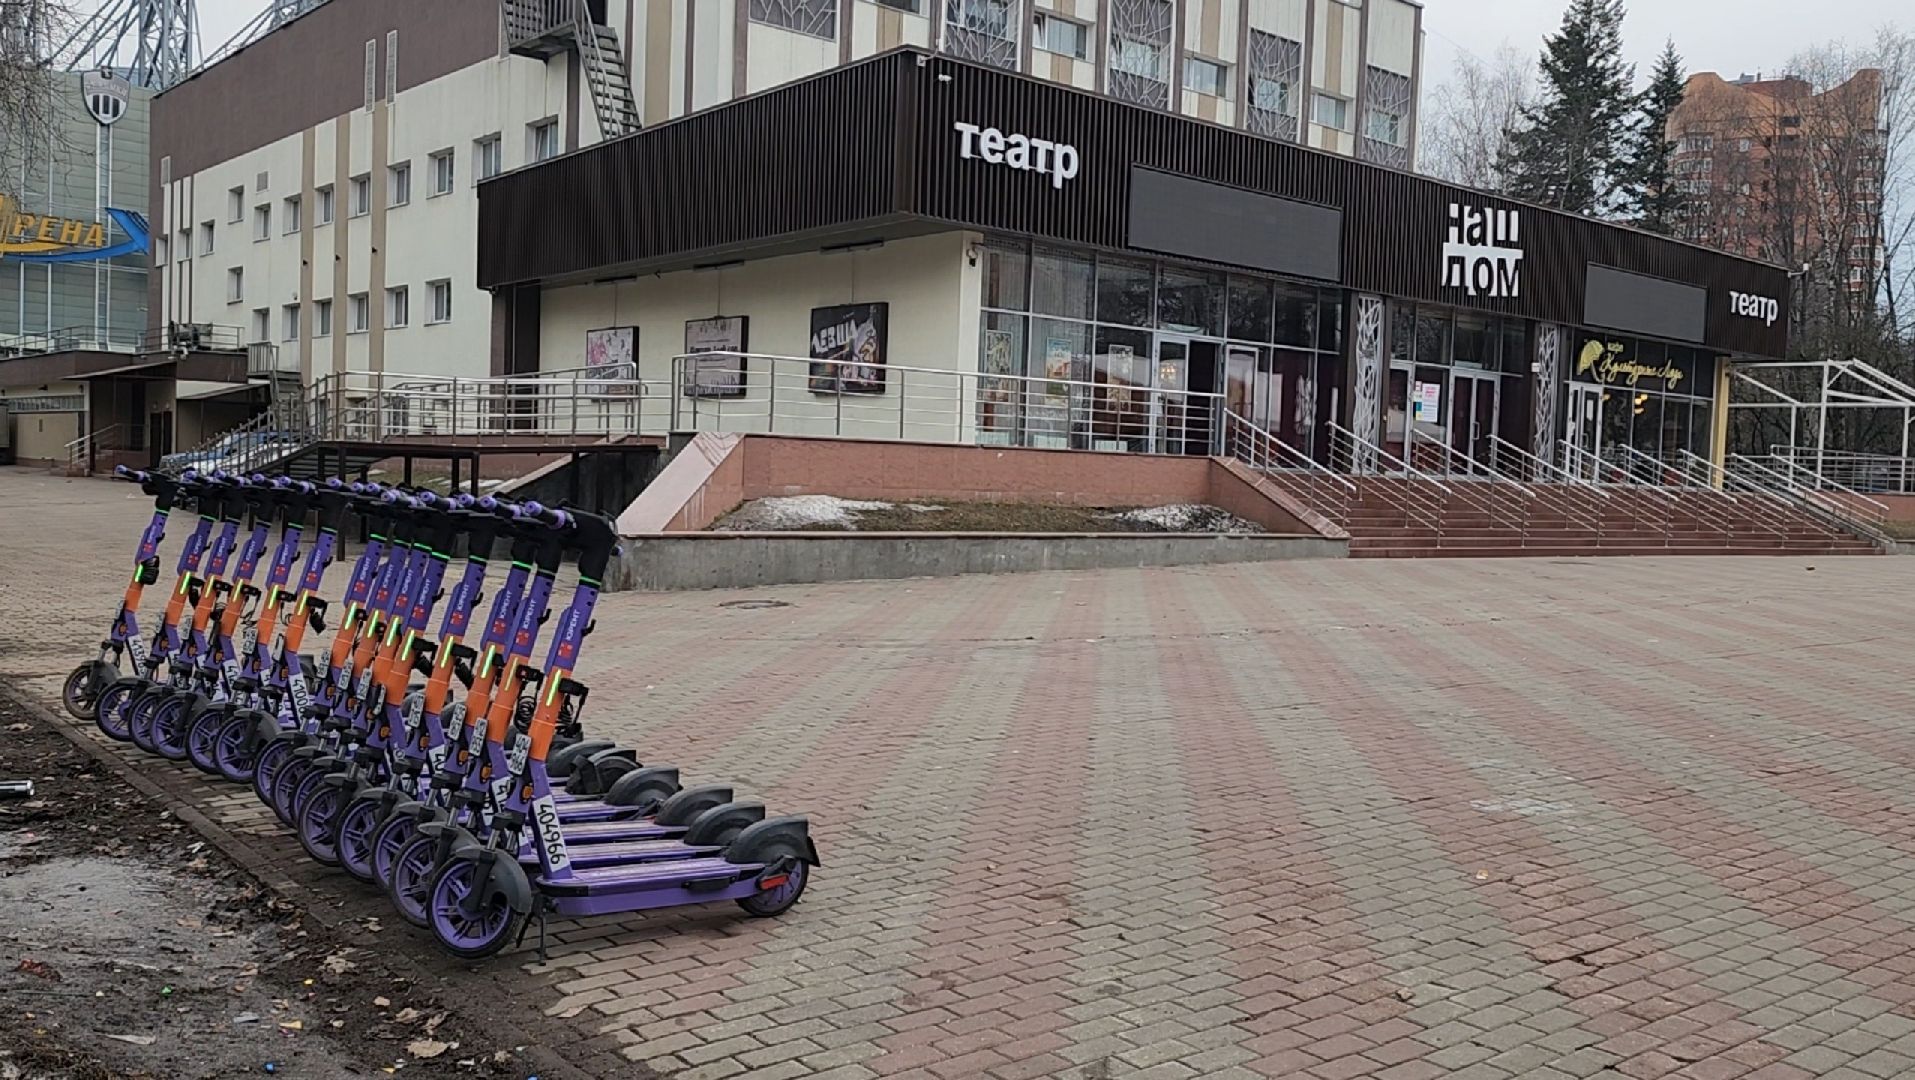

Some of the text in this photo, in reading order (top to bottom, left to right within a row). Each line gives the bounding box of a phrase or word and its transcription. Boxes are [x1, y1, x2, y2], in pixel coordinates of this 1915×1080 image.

[954, 121, 1079, 190] театр
[1729, 290, 1779, 328] театр
[811, 319, 859, 354] ЛЕВША
[522, 599, 538, 630] ЮРЕНТ
[566, 609, 582, 642] ЮРЕНТ
[536, 803, 567, 866] 404966
